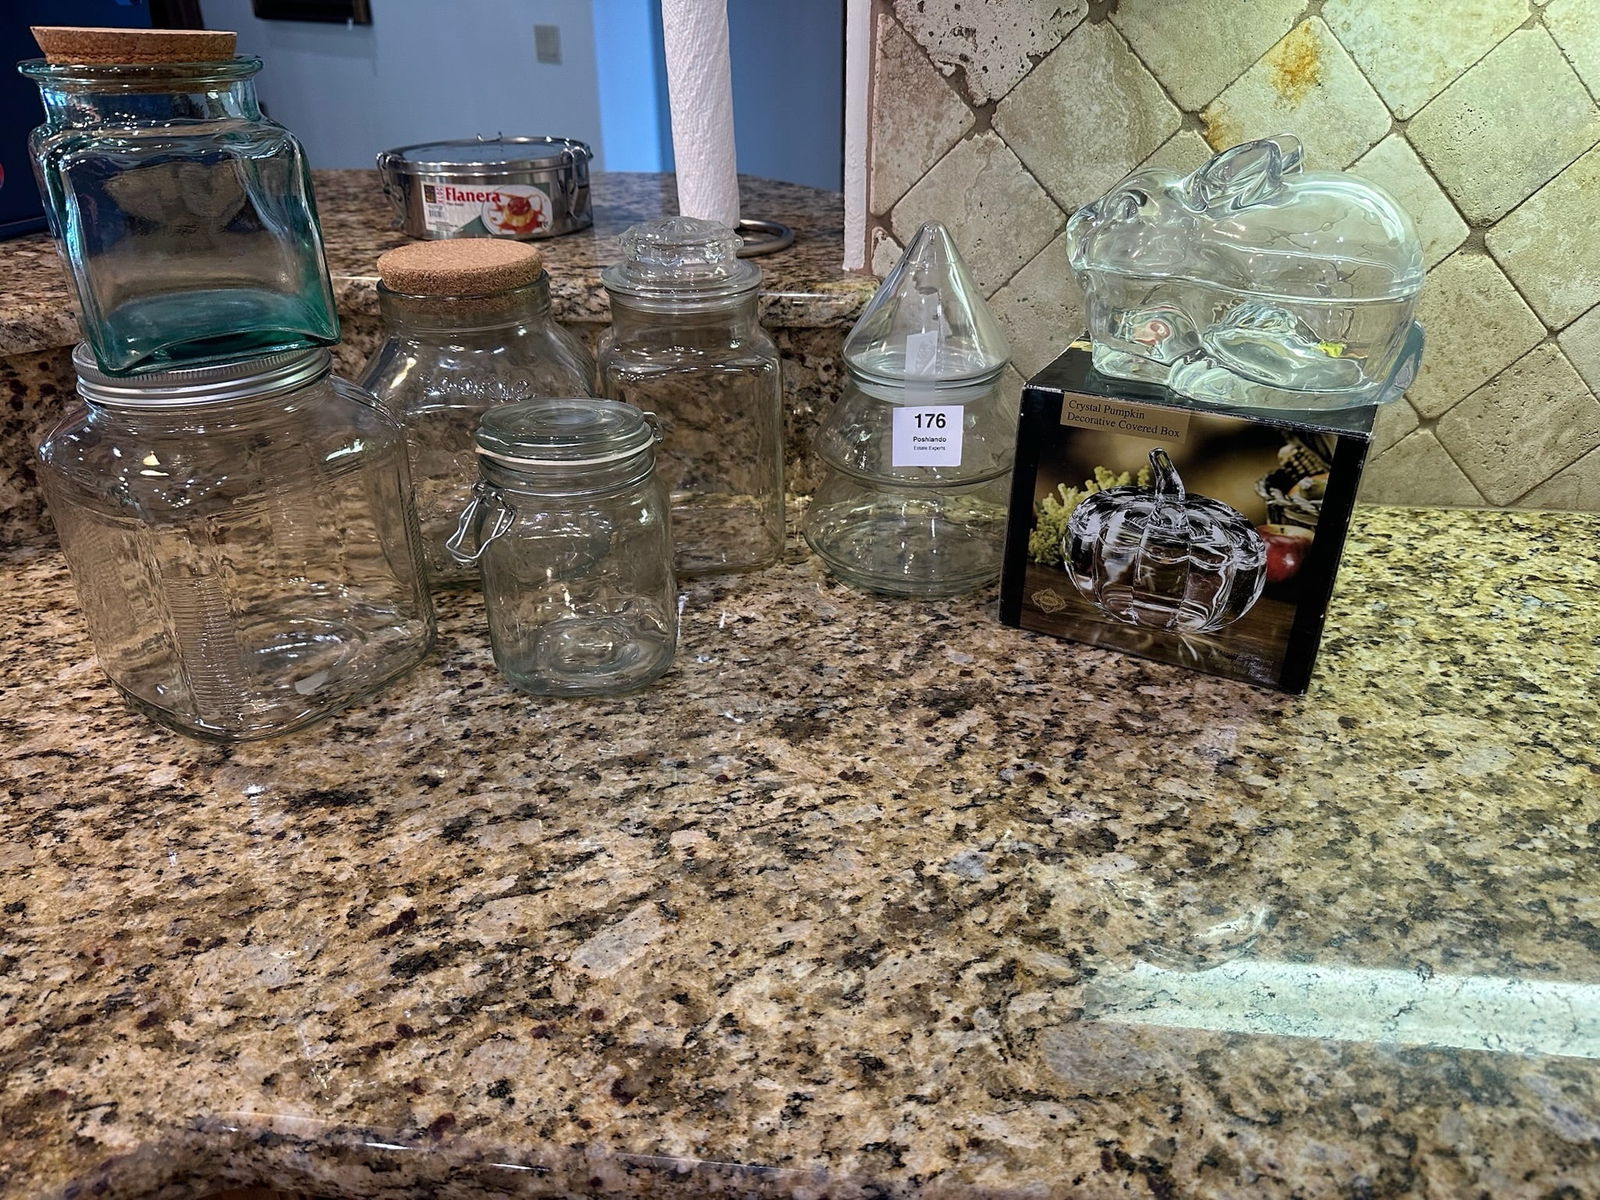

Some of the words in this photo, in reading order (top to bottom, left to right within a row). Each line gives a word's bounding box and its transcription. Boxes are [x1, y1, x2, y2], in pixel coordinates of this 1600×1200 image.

[444, 186, 502, 203] Flanera
[1068, 399, 1101, 413] Crystal
[1103, 404, 1145, 420] Pumpkin
[914, 413, 946, 429] 176
[1067, 411, 1116, 428] Decorative
[1118, 420, 1158, 434] Covered
[1160, 426, 1180, 438] Box
[912, 435, 947, 443] Poshlando
